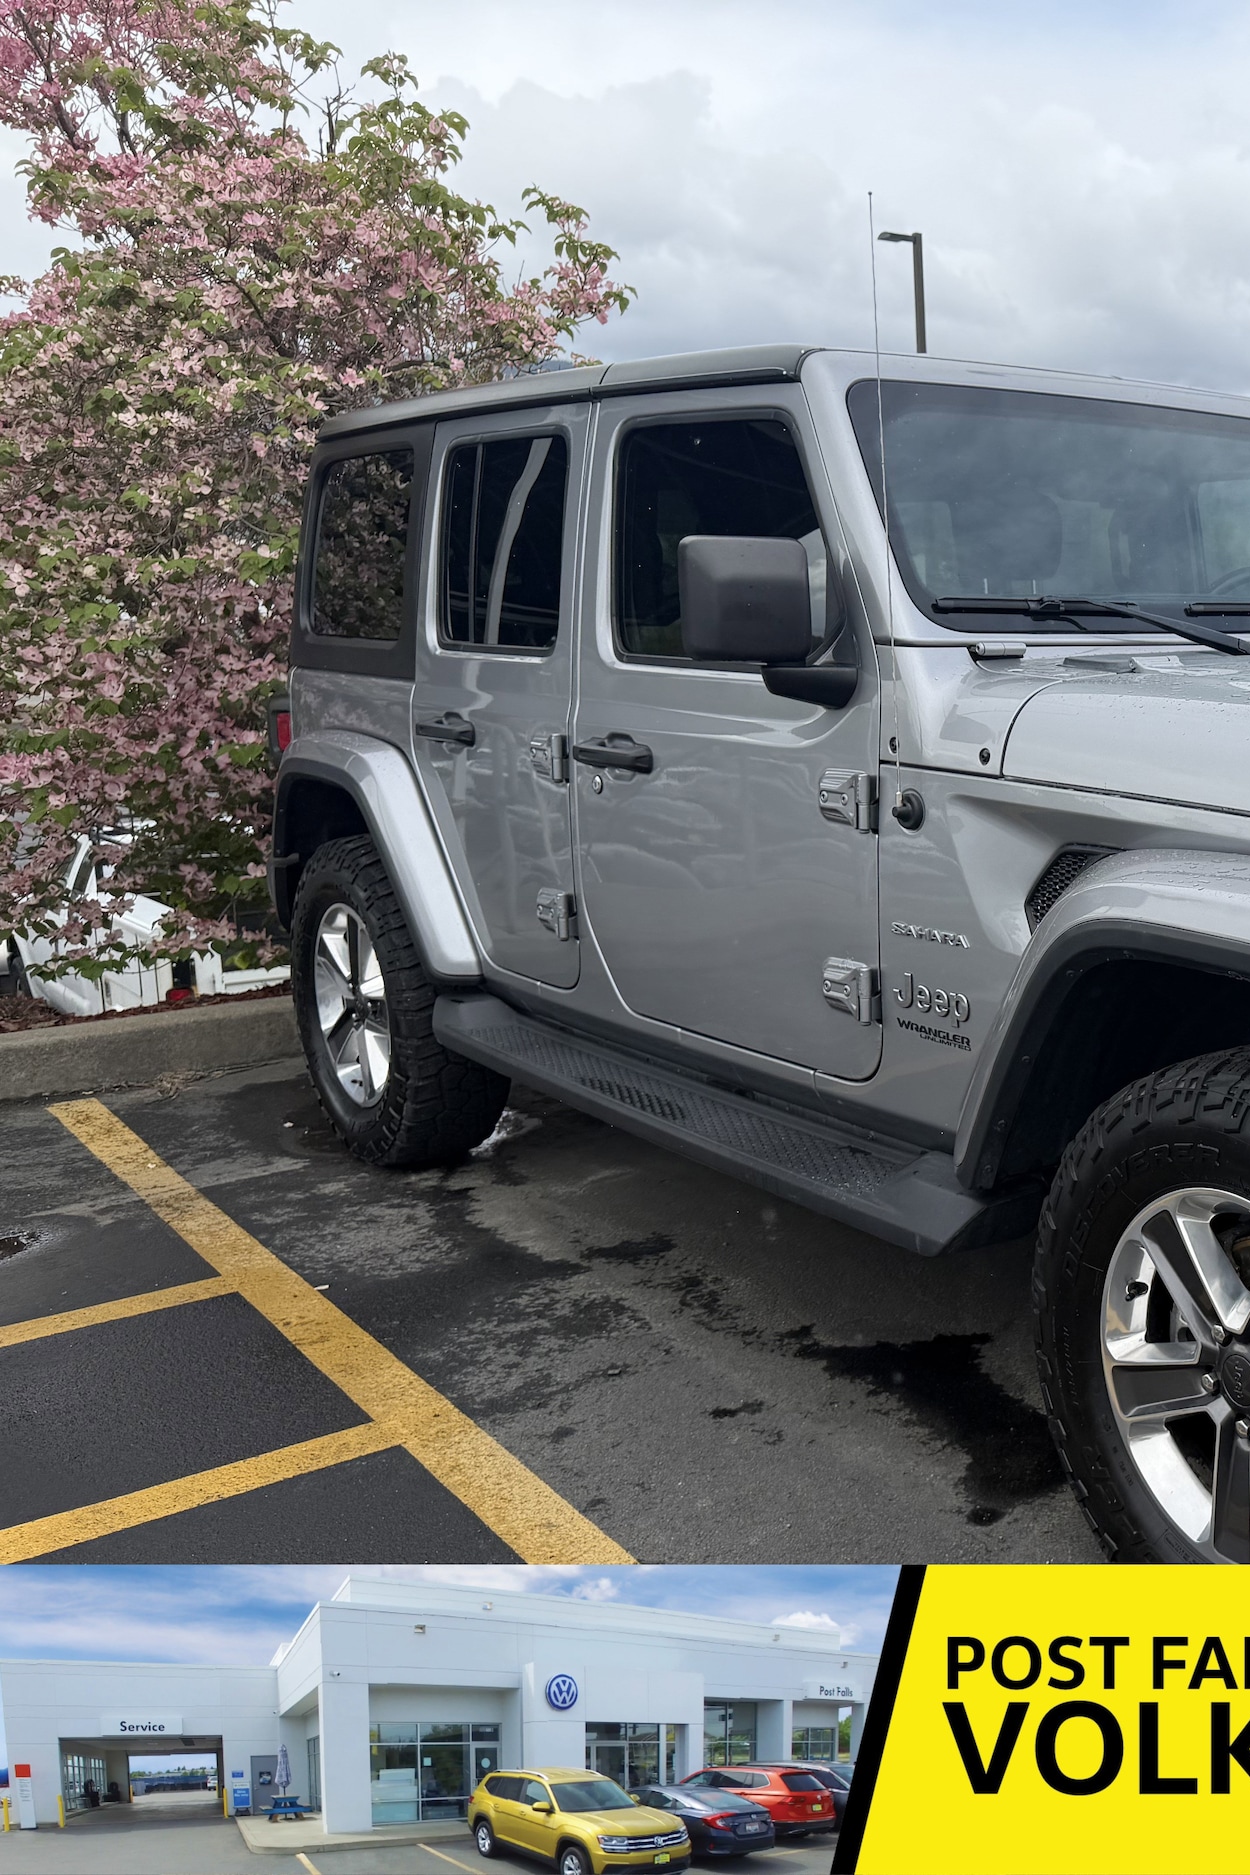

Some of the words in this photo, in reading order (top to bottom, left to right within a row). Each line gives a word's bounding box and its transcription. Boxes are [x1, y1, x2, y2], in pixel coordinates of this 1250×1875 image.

[891, 921, 970, 949] SAHARA
[893, 972, 970, 1028] Jeep
[897, 1017, 971, 1046] WRANGLER
[919, 1033, 971, 1051] UNLIMITED
